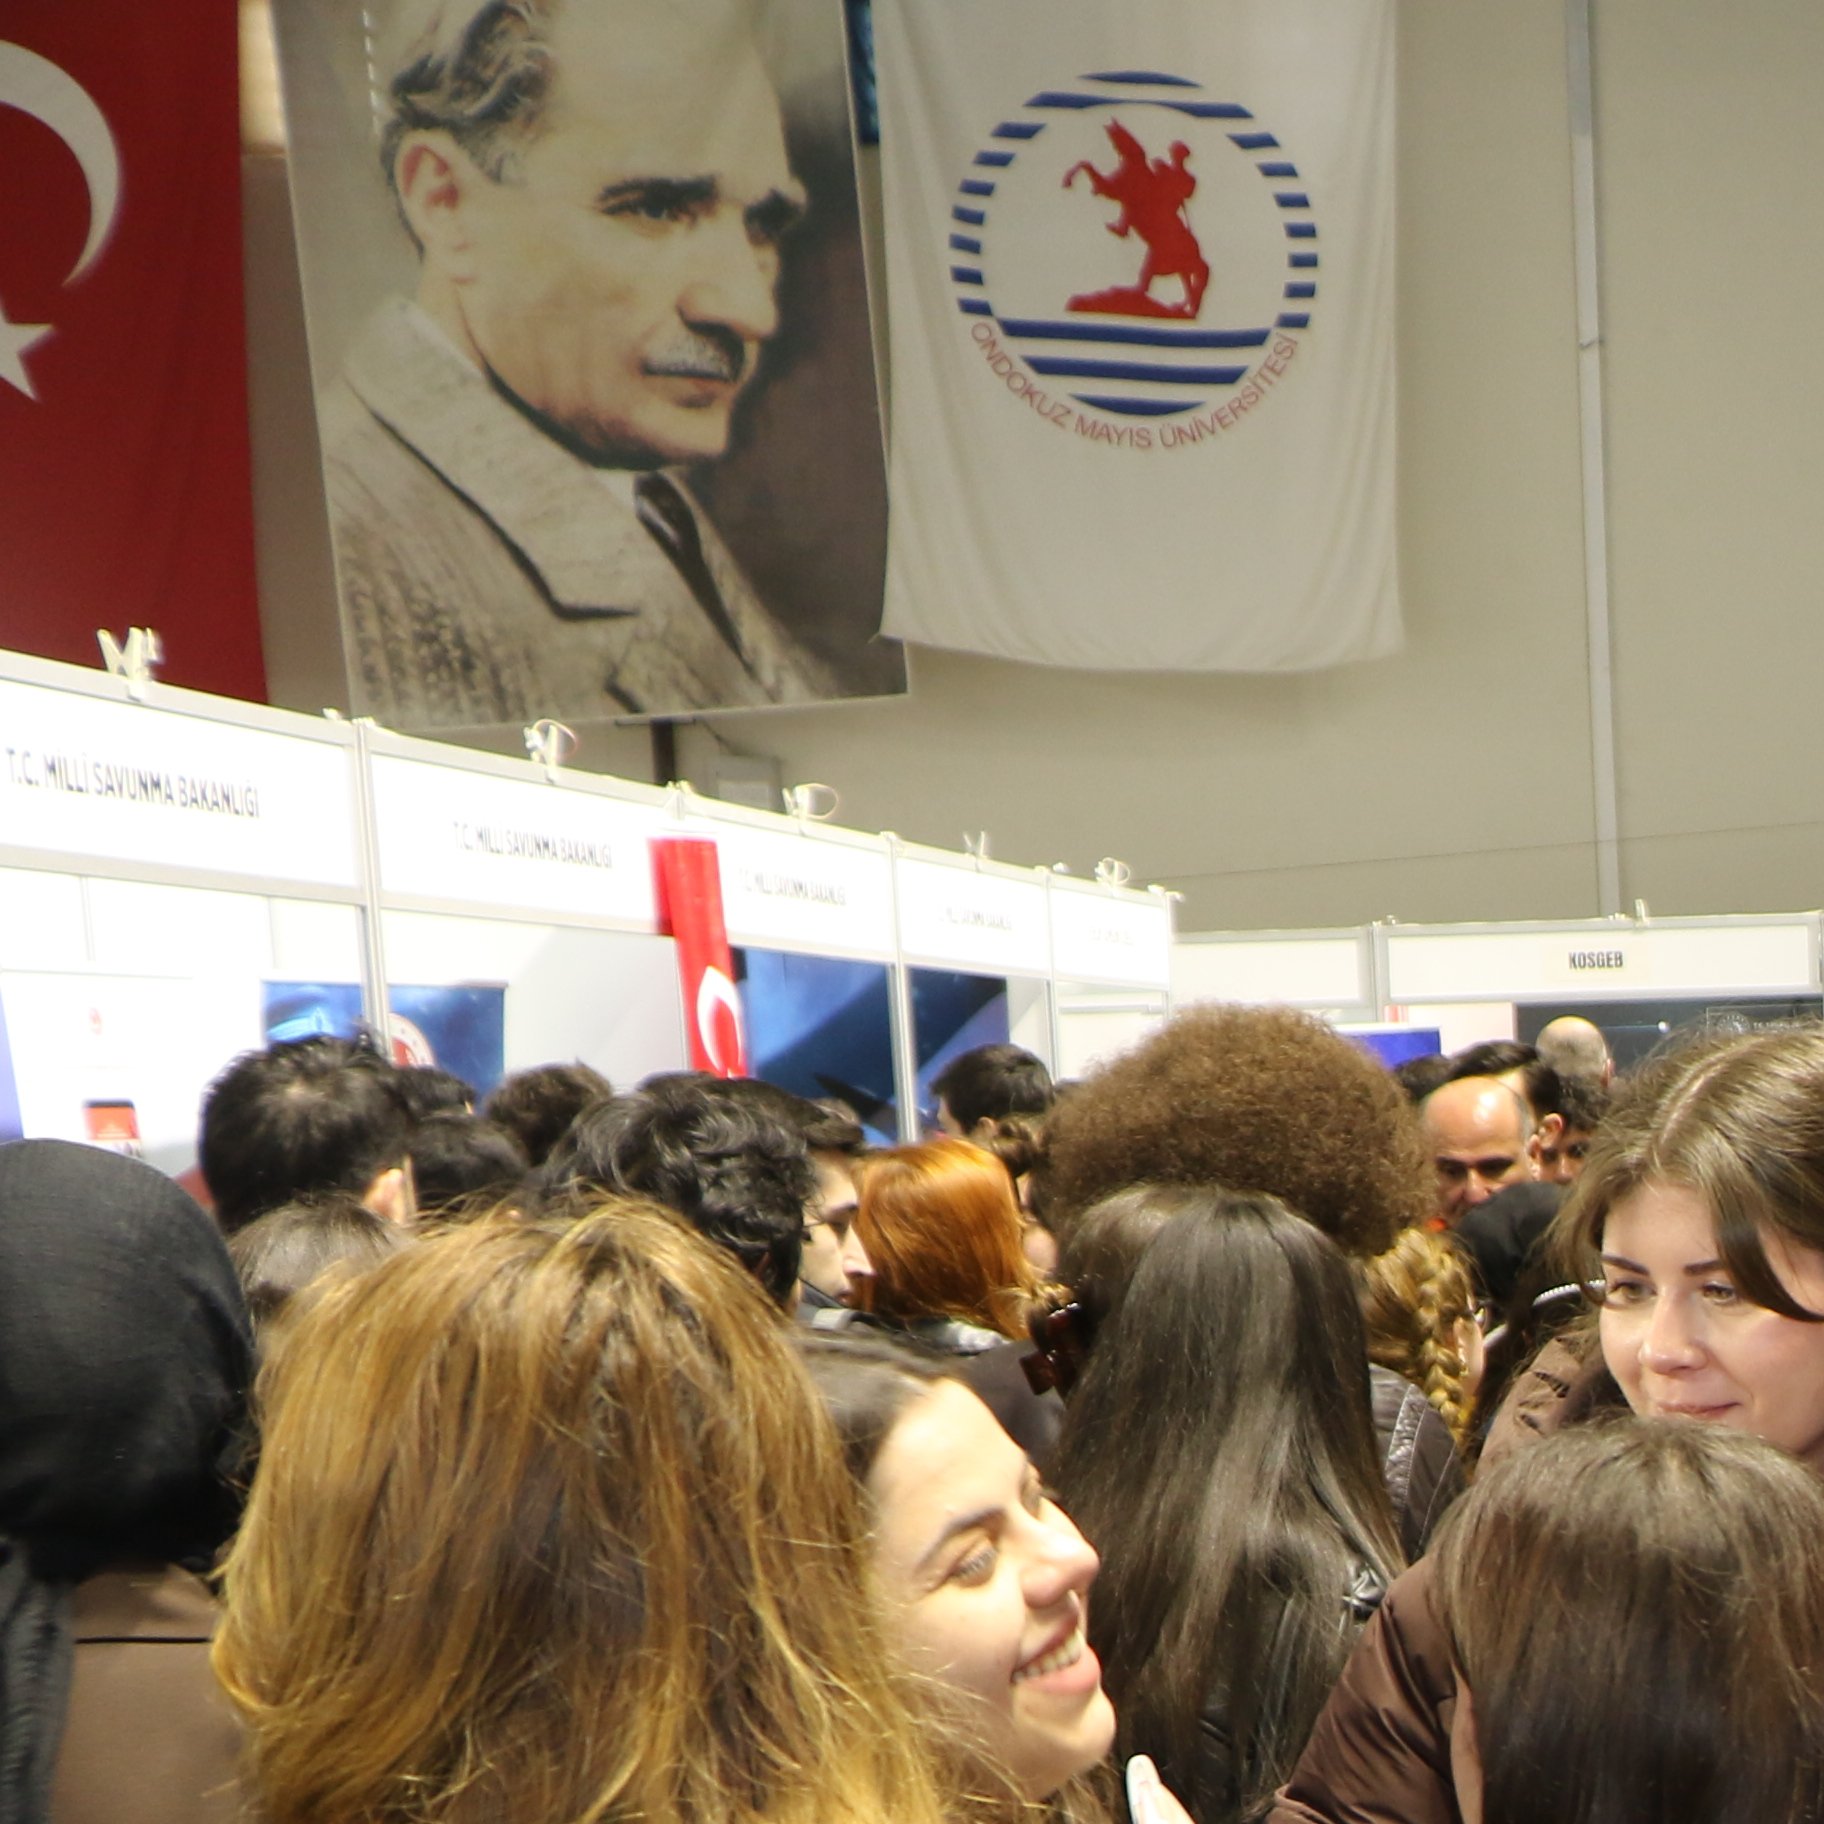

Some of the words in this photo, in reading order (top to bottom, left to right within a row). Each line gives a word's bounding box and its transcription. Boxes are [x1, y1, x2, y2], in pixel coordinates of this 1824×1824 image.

[970, 321, 1073, 429] ONDOKUZ
[1074, 413, 1152, 449] MAYIS
[1159, 332, 1299, 449] ÜNİVERSİTESİ
[6, 748, 40, 787] T.C.
[93, 762, 176, 806] SAVUNMA
[507, 829, 559, 862] SAVUNMA
[1568, 950, 1624, 970] KOSGEB
